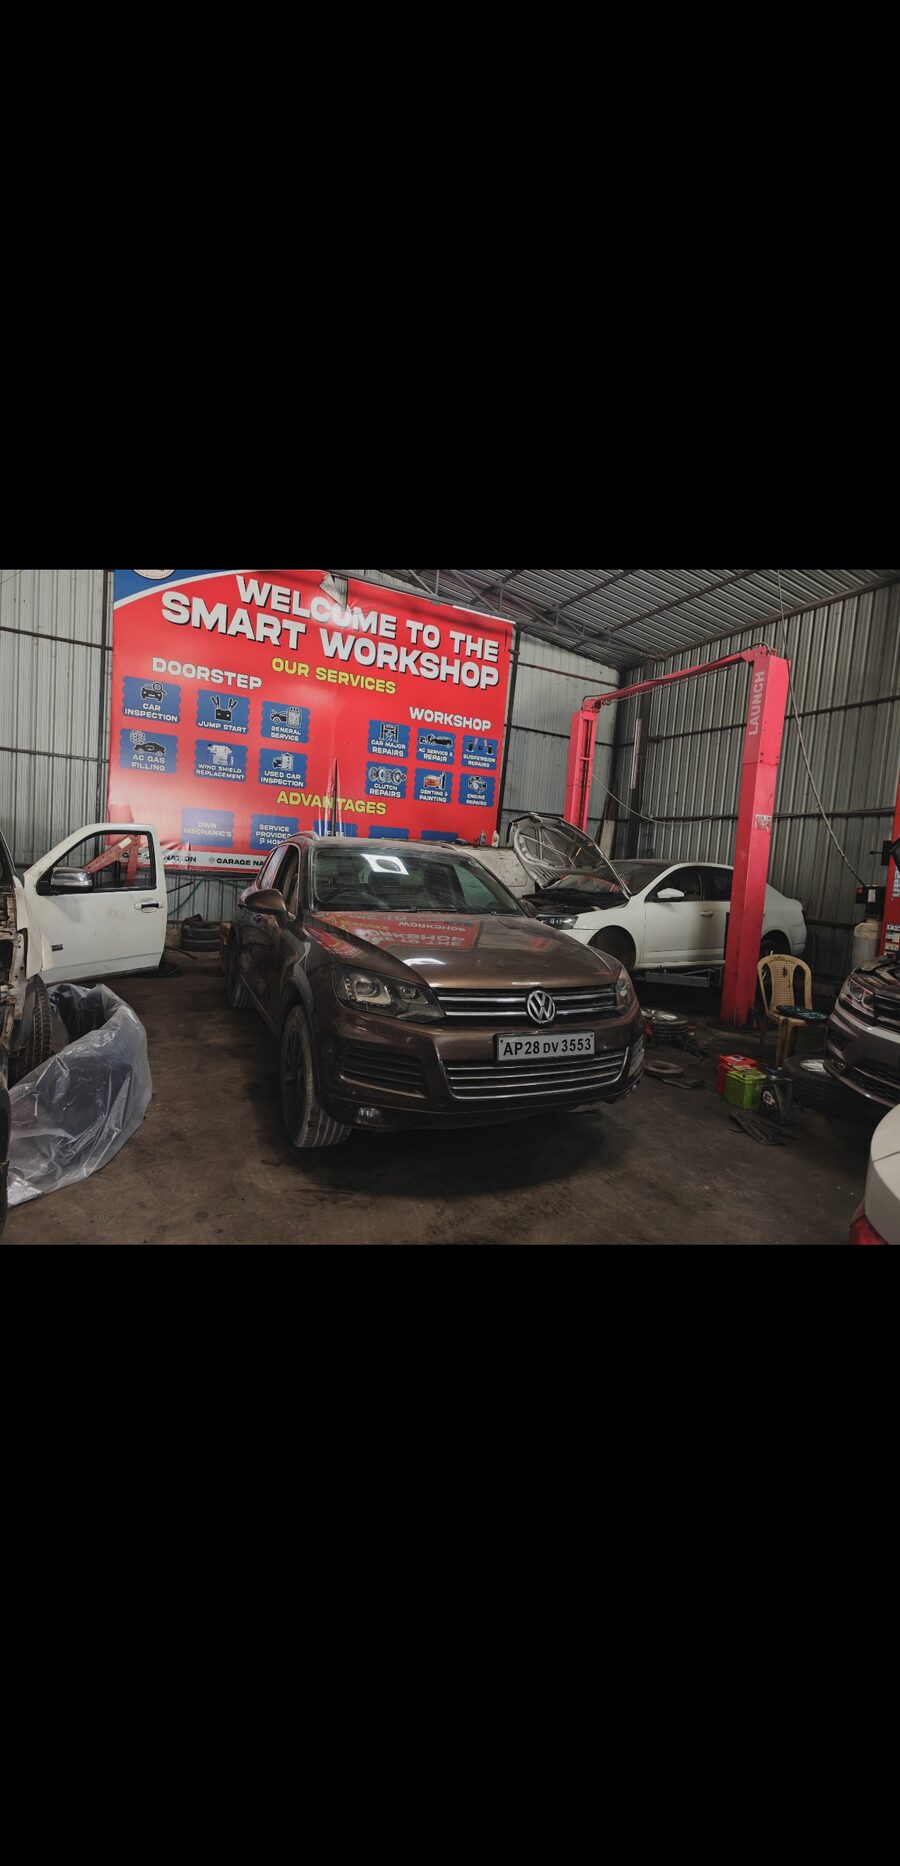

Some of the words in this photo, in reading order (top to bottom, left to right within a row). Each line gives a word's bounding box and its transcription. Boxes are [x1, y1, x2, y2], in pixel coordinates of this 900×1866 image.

[236, 575, 397, 640] WELCOME
[406, 620, 441, 649] TO
[450, 631, 499, 663] THE
[162, 591, 306, 650] SMART
[320, 628, 499, 690] WORKSHOP
[153, 657, 263, 690] DOORSTEP
[272, 658, 310, 678] OUR
[316, 667, 396, 695] SERVICES
[143, 703, 161, 712] CAR
[749, 672, 765, 736] LAUNCH
[125, 708, 178, 722] INSPECTION
[409, 707, 492, 732] WORKSHOP
[198, 721, 221, 729] JUMP
[224, 725, 247, 733] START
[272, 726, 301, 735] GENERAL
[271, 732, 299, 742] SERVICE
[385, 741, 406, 750] MAJOR
[372, 747, 404, 757] REPAIRS
[427, 749, 449, 757] SERVICE
[148, 756, 166, 764] GAS
[424, 753, 448, 762] REPAIR
[463, 754, 496, 763] SUSPENSION
[132, 762, 166, 772] FILLING
[196, 769, 245, 780] REPLACEMENT
[264, 770, 284, 779] USED
[261, 777, 304, 787] INSPECTION
[374, 783, 398, 791] CLUTCH
[370, 788, 401, 798] REPAIRS
[421, 789, 443, 797] DENTING
[276, 791, 387, 815] ADVANTAGES
[419, 795, 447, 803] PAINTING
[260, 824, 290, 832] SERVICE
[164, 854, 197, 862] NATON
[217, 858, 250, 866] GARAGE
[503, 1041, 540, 1056] AP28
[544, 1042, 559, 1054] DV
[562, 1038, 591, 1052] 3553
